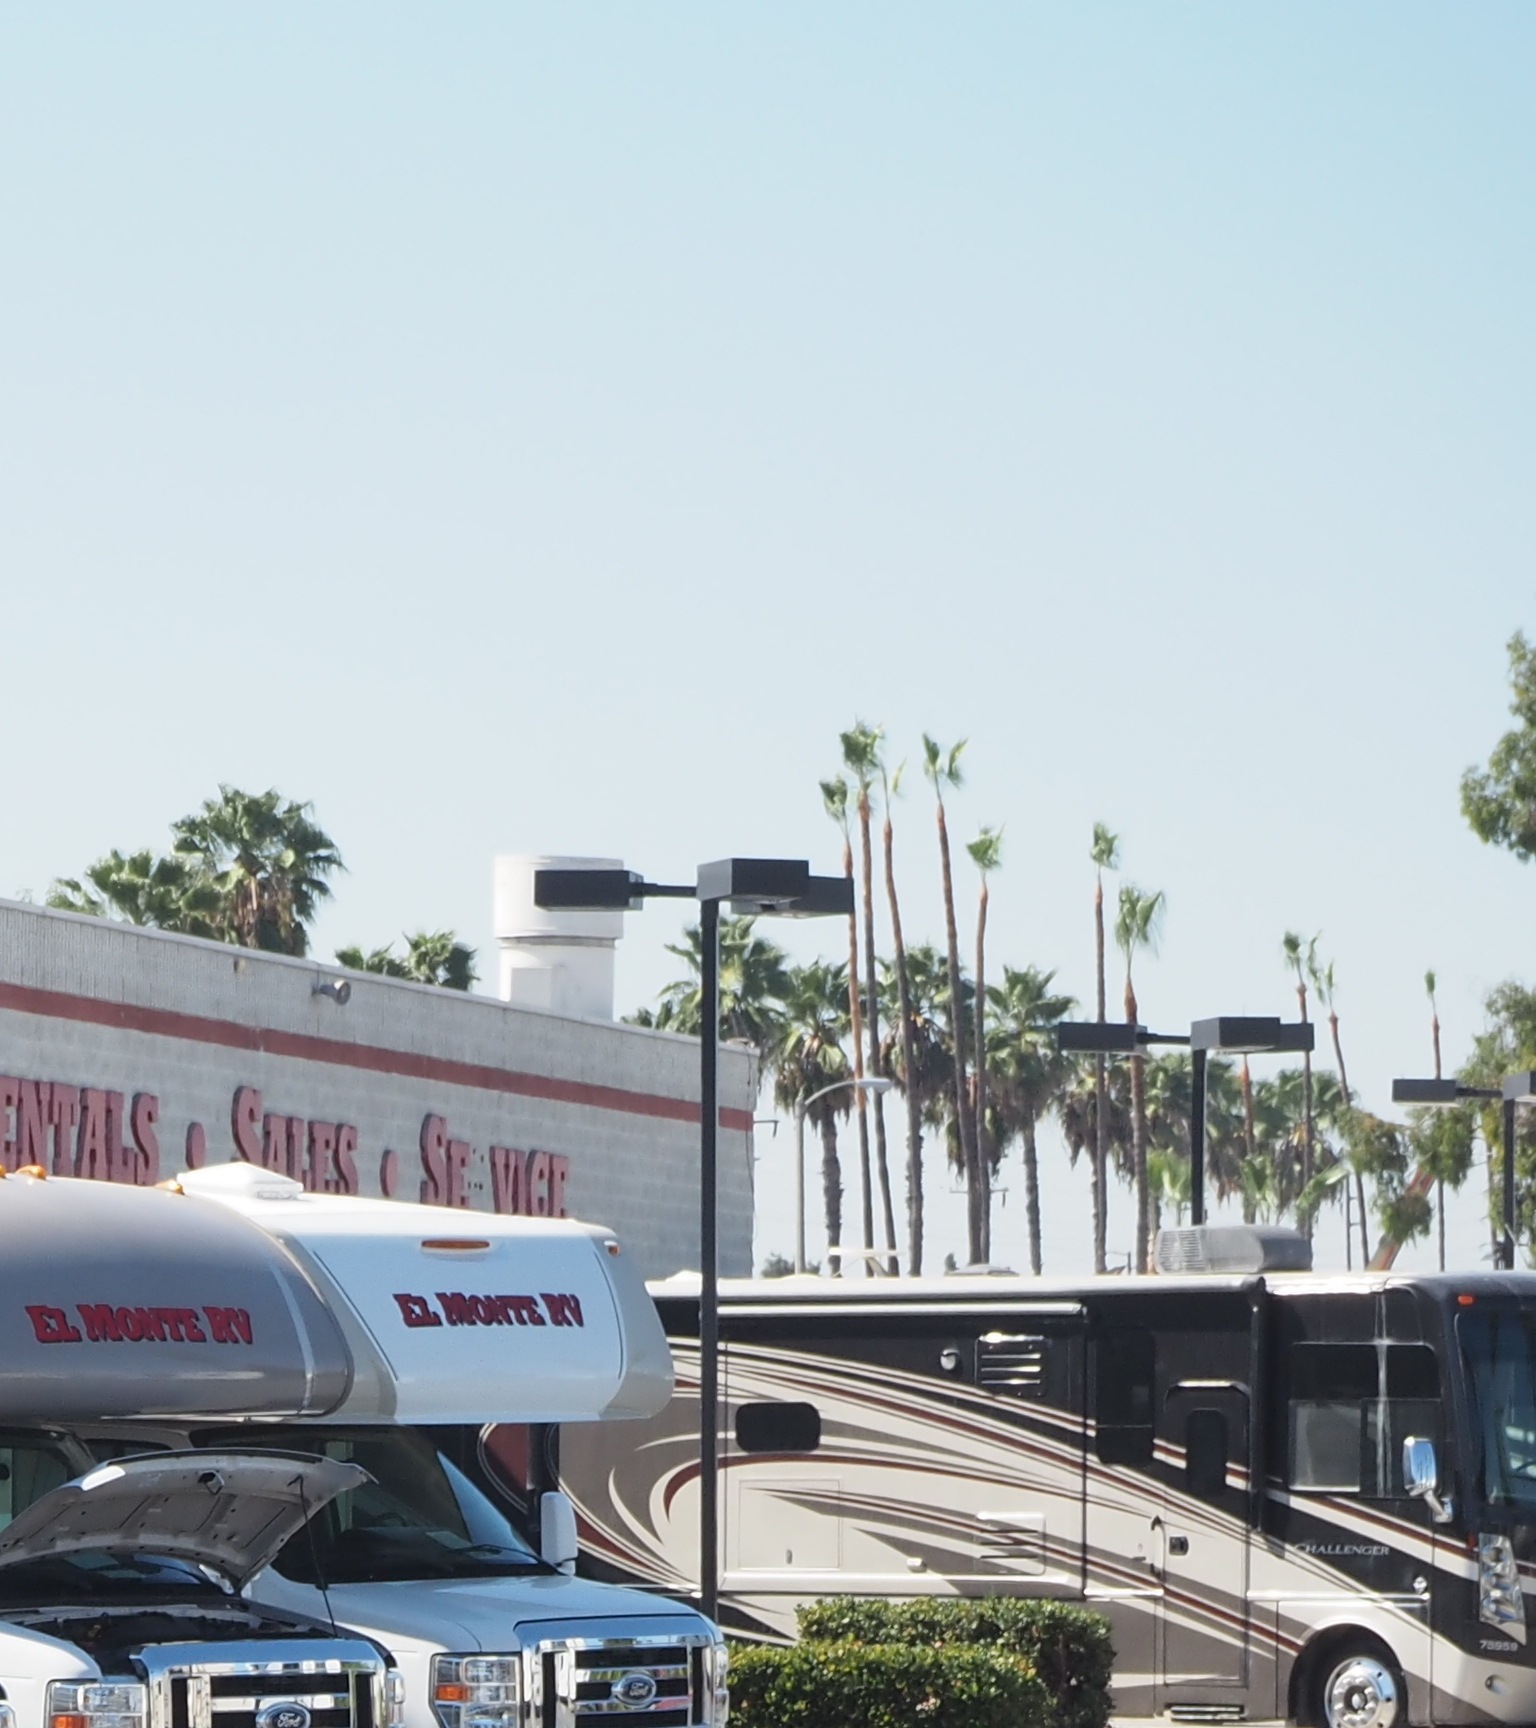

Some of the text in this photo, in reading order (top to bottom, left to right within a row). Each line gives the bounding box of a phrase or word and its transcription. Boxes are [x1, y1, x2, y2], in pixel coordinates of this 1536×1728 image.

[232, 1085, 360, 1196] SALES
[25, 1304, 254, 1345] EL MONTE RV
[391, 1292, 585, 1328] EL MONTE RV
[1294, 1542, 1390, 1556] CHALLENGER
[277, 1712, 302, 1728] Ford
